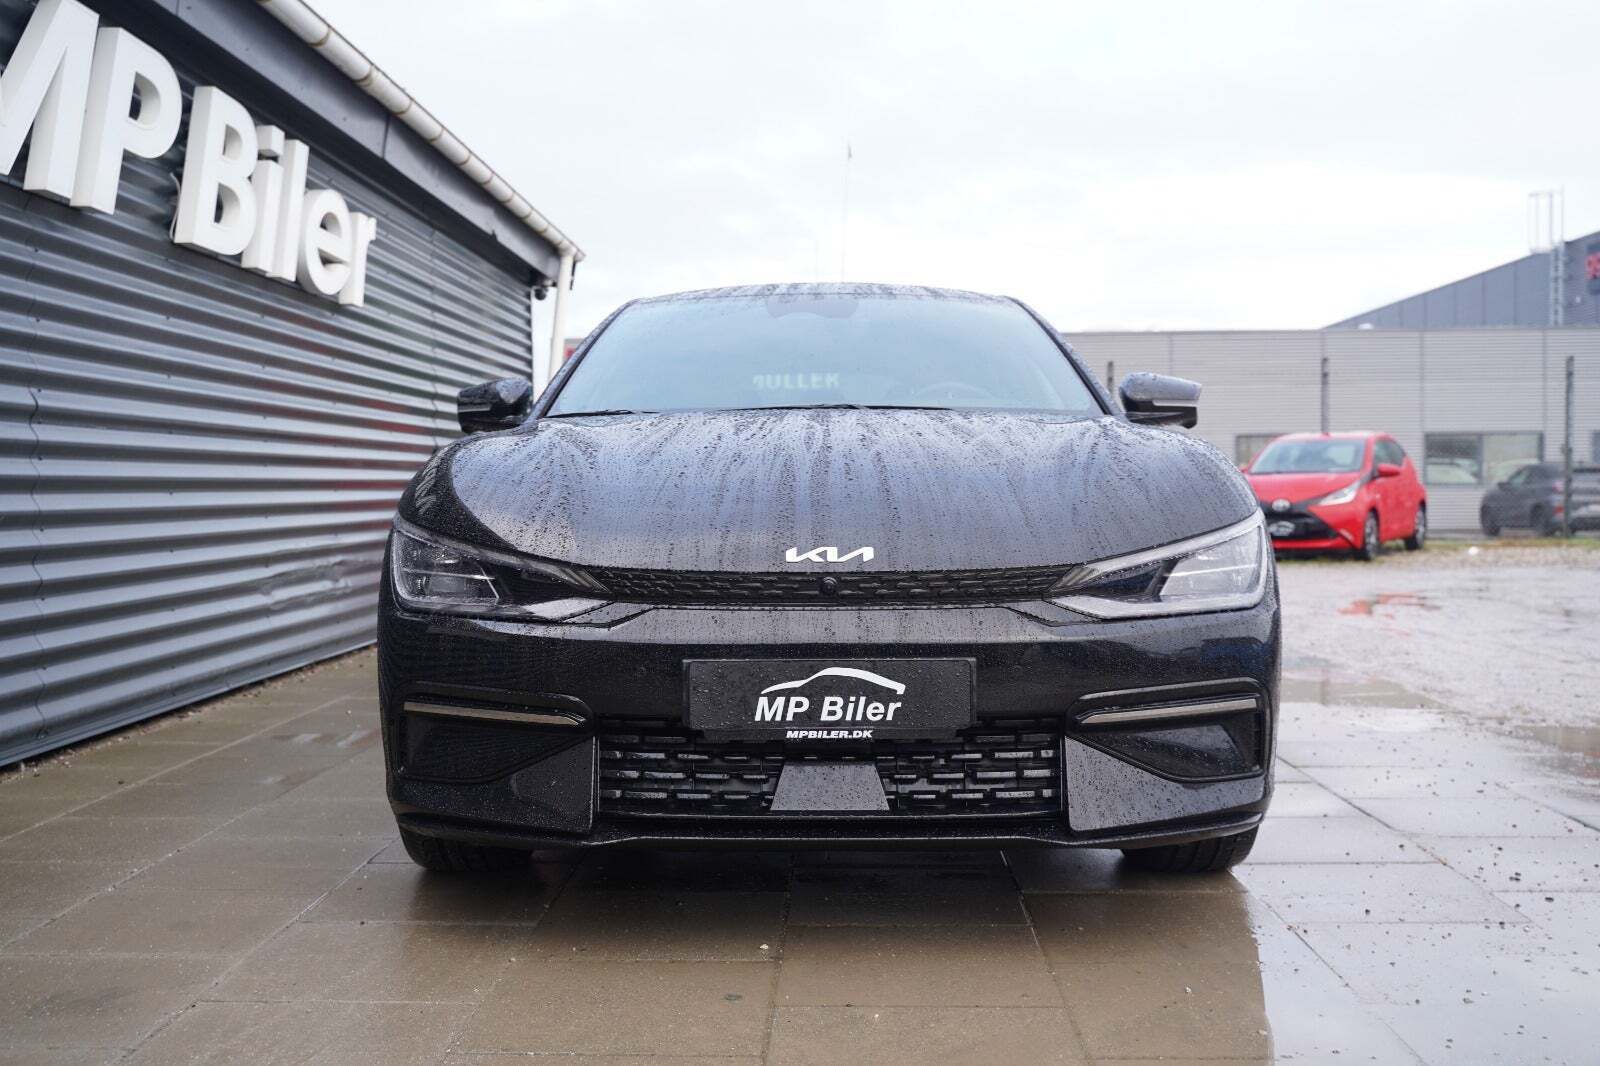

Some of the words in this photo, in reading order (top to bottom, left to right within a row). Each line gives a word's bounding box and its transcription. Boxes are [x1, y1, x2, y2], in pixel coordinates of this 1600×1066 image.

[0, 0, 183, 215] MP
[173, 86, 377, 307] Biler
[785, 546, 875, 563] KIA
[754, 696, 810, 722] MP
[820, 695, 902, 722] Biler
[785, 729, 874, 740] MPBILER.DK
